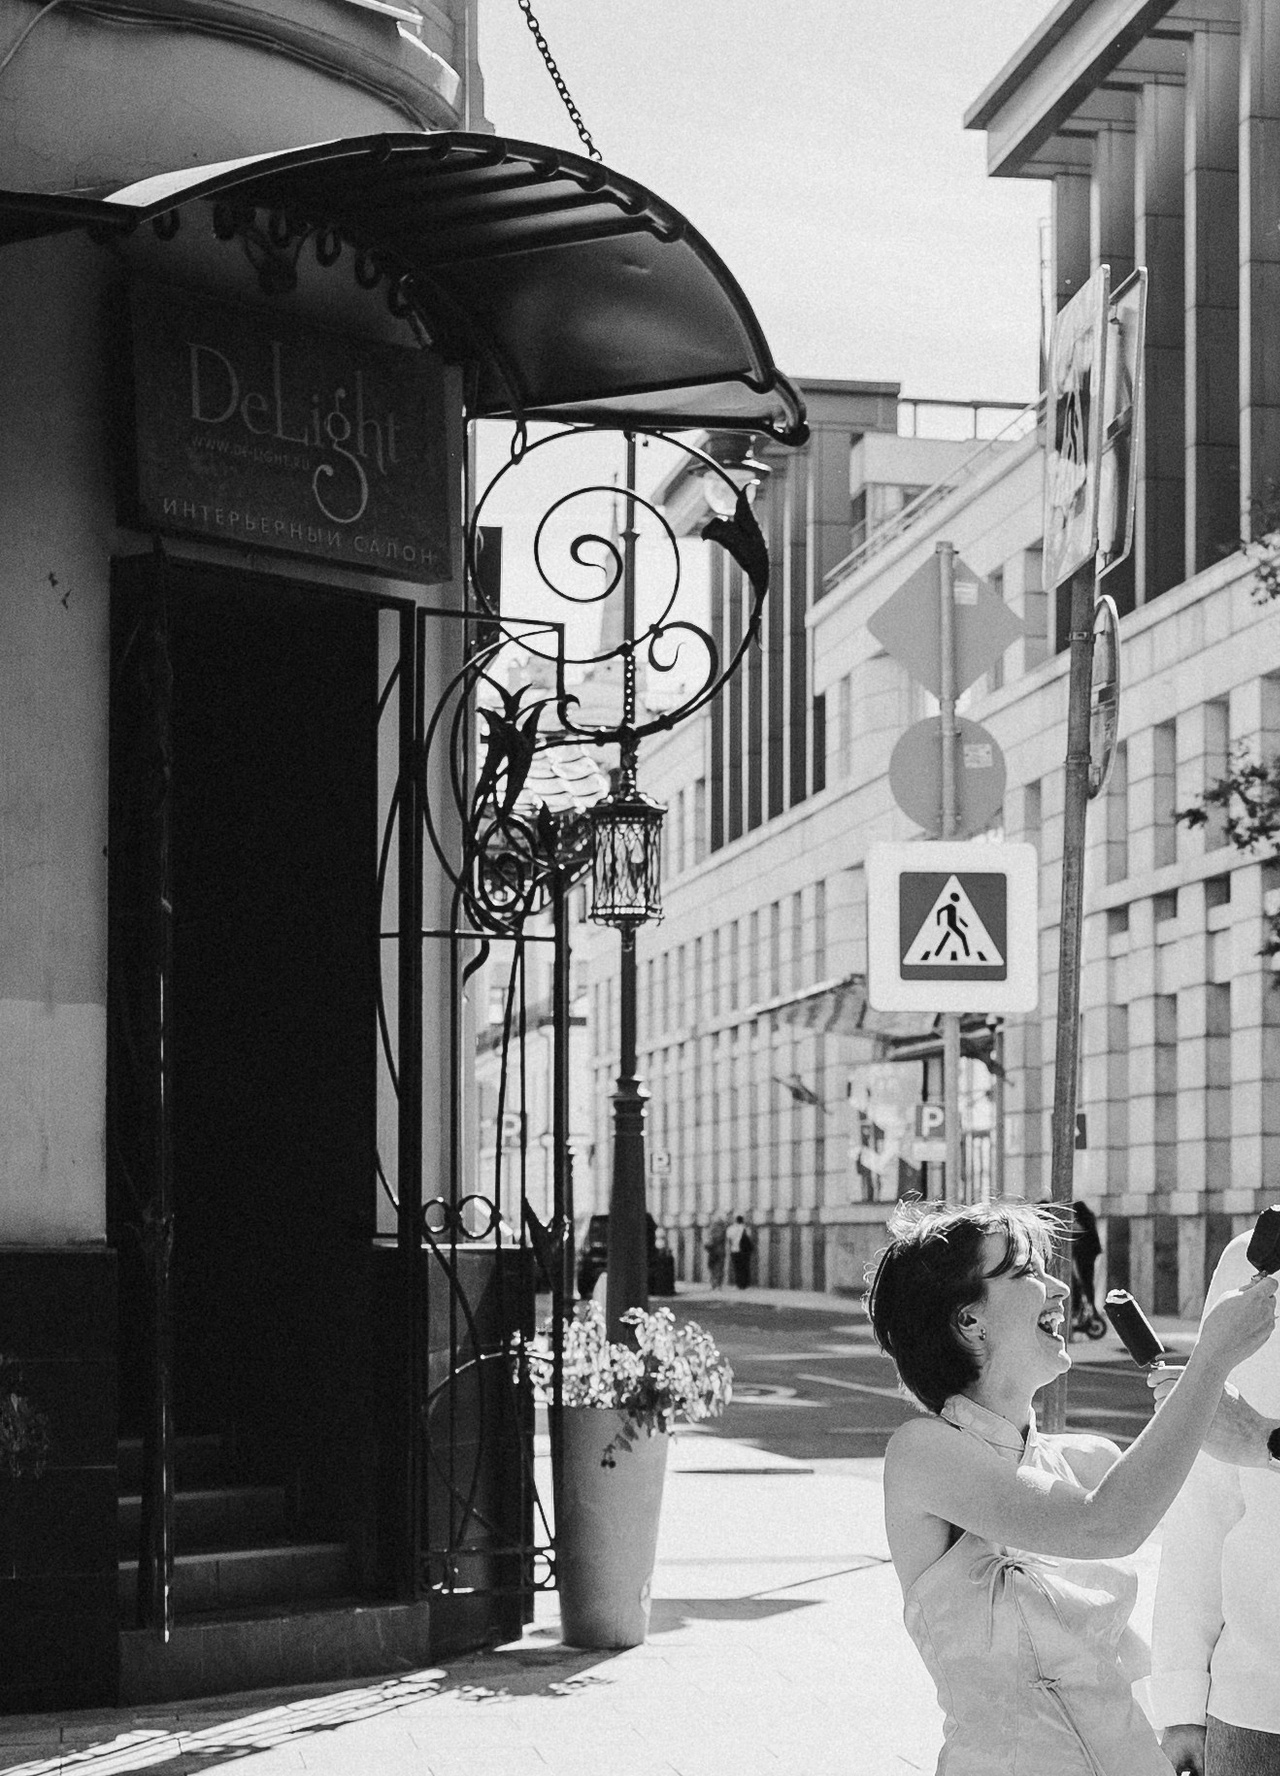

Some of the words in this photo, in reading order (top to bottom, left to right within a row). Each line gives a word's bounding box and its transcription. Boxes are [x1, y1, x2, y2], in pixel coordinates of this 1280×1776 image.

[187, 341, 400, 525] DeLight
[353, 535, 435, 565] САЛОН
[921, 1106, 945, 1137] P
